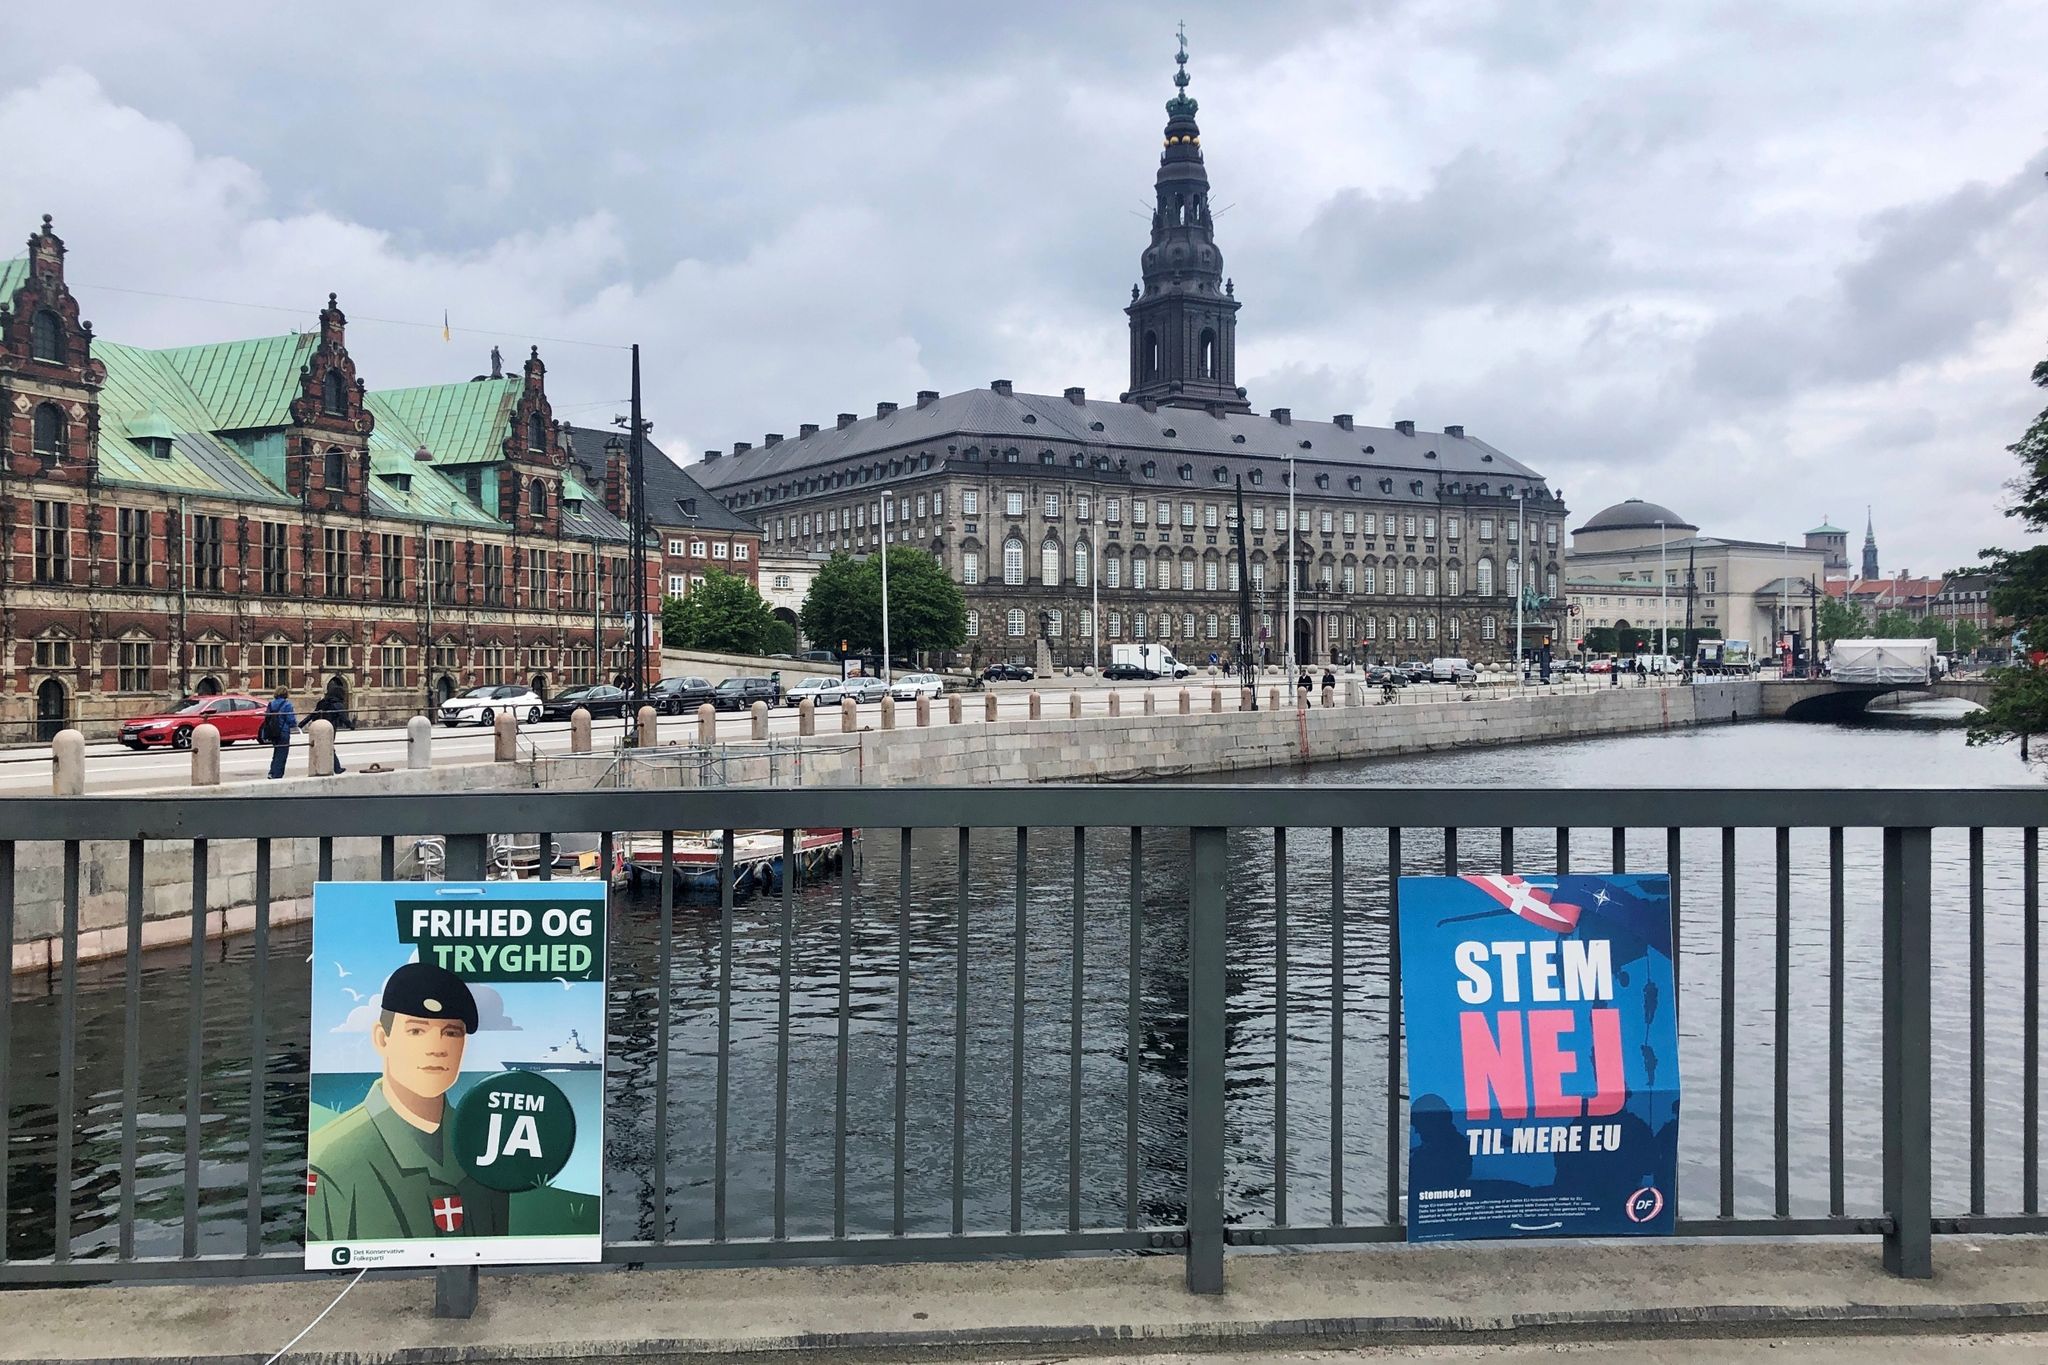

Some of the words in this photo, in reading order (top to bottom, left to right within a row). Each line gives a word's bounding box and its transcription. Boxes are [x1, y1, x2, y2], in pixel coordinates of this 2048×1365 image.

[412, 909, 532, 938] FRIHED
[541, 908, 592, 937] OG
[433, 943, 592, 973] TRYGHED
[1454, 939, 1614, 1004] STEM
[1459, 1008, 1626, 1120] NEJ
[488, 1091, 545, 1113] STEM
[476, 1113, 543, 1166] JA
[1466, 1129, 1505, 1156] TIL
[1511, 1125, 1582, 1154] MERE
[1589, 1124, 1622, 1151] EU
[1419, 1188, 1472, 1201] stemnej.eu
[1635, 1199, 1654, 1210] DF
[365, 1248, 405, 1256] Konservative
